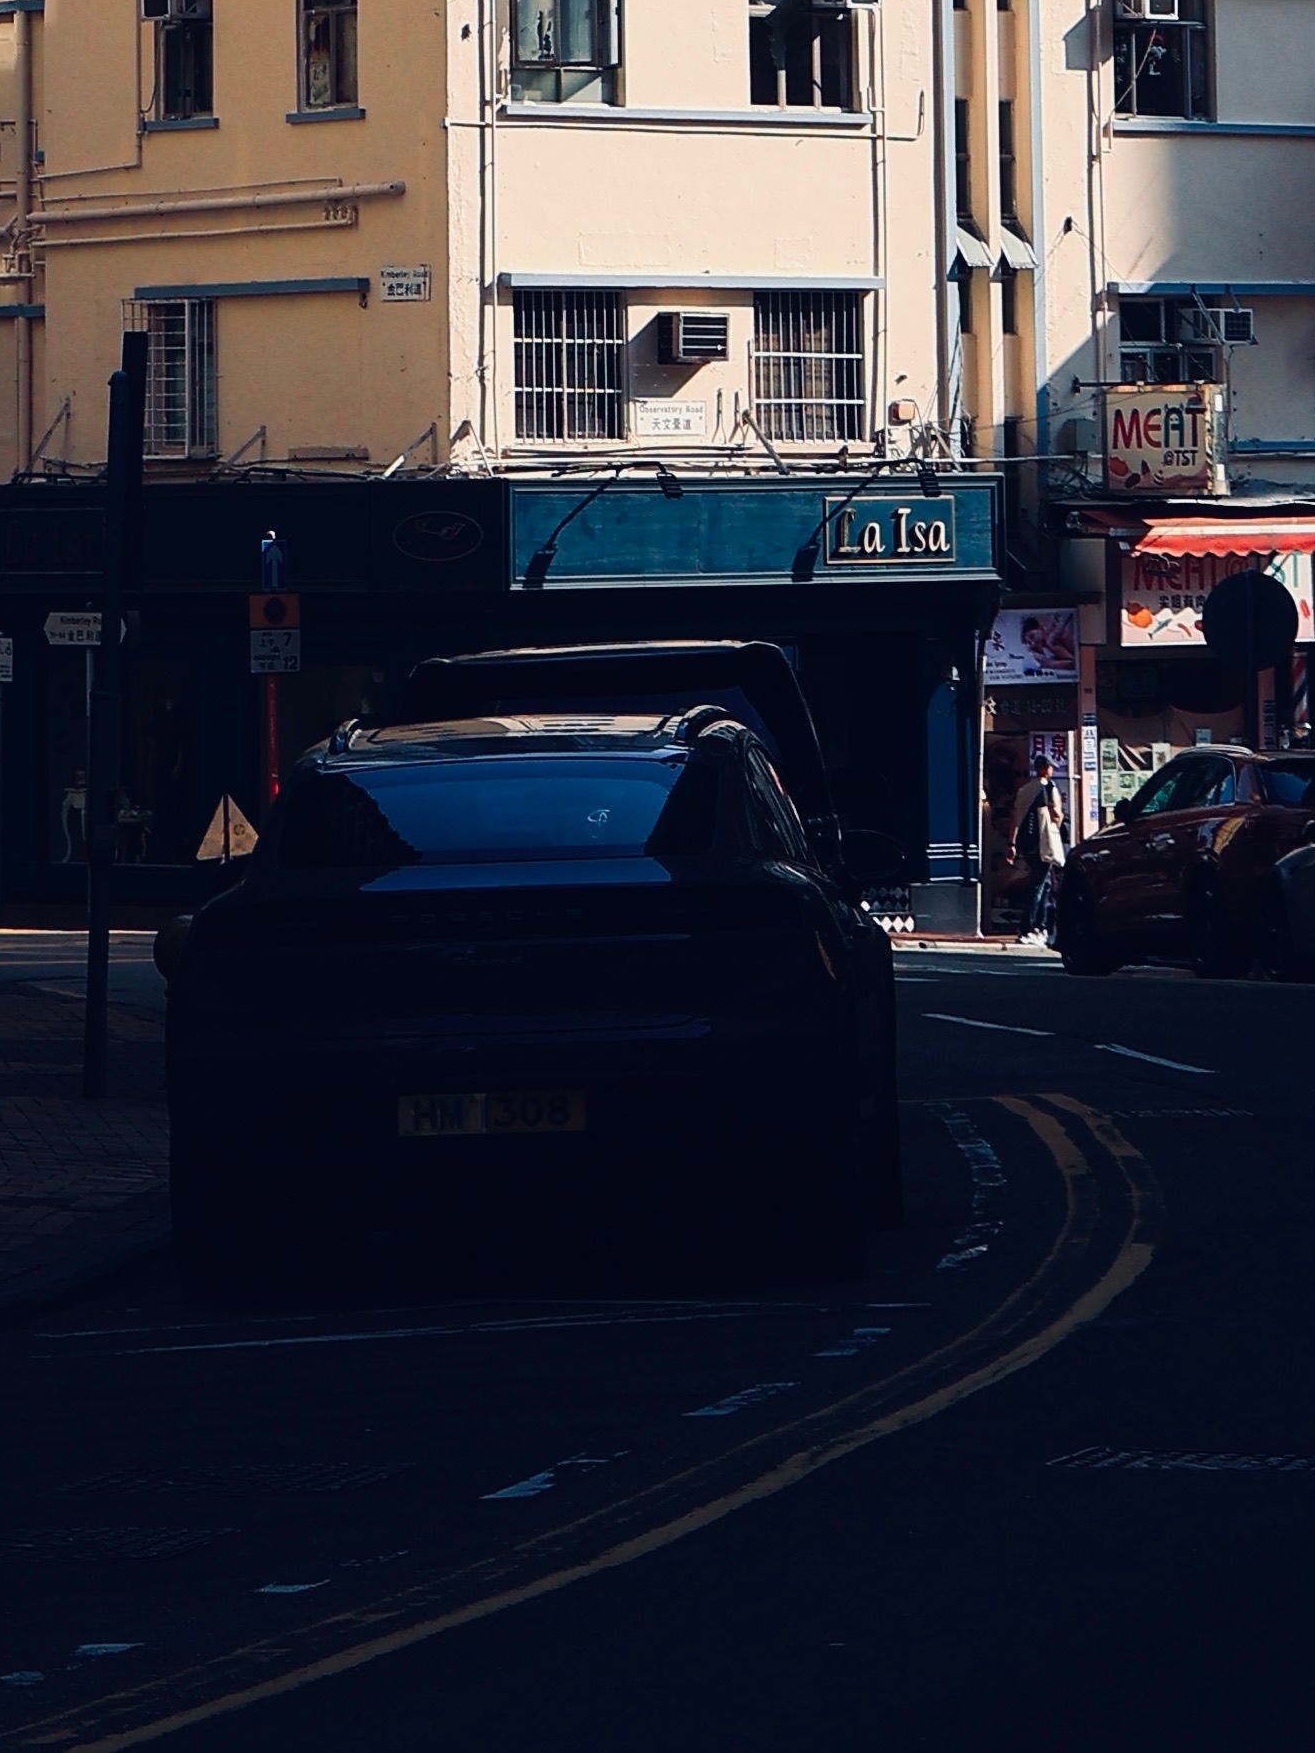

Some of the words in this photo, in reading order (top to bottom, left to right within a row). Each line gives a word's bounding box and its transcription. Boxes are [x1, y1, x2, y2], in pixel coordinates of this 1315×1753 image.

[638, 404, 682, 414] Observatory
[685, 404, 703, 414] Road
[1112, 404, 1206, 450] MEAT
[1163, 449, 1198, 467] @TST
[837, 507, 885, 554] La
[895, 507, 951, 554] Isa
[283, 632, 292, 647] 7
[283, 655, 297, 671] 12
